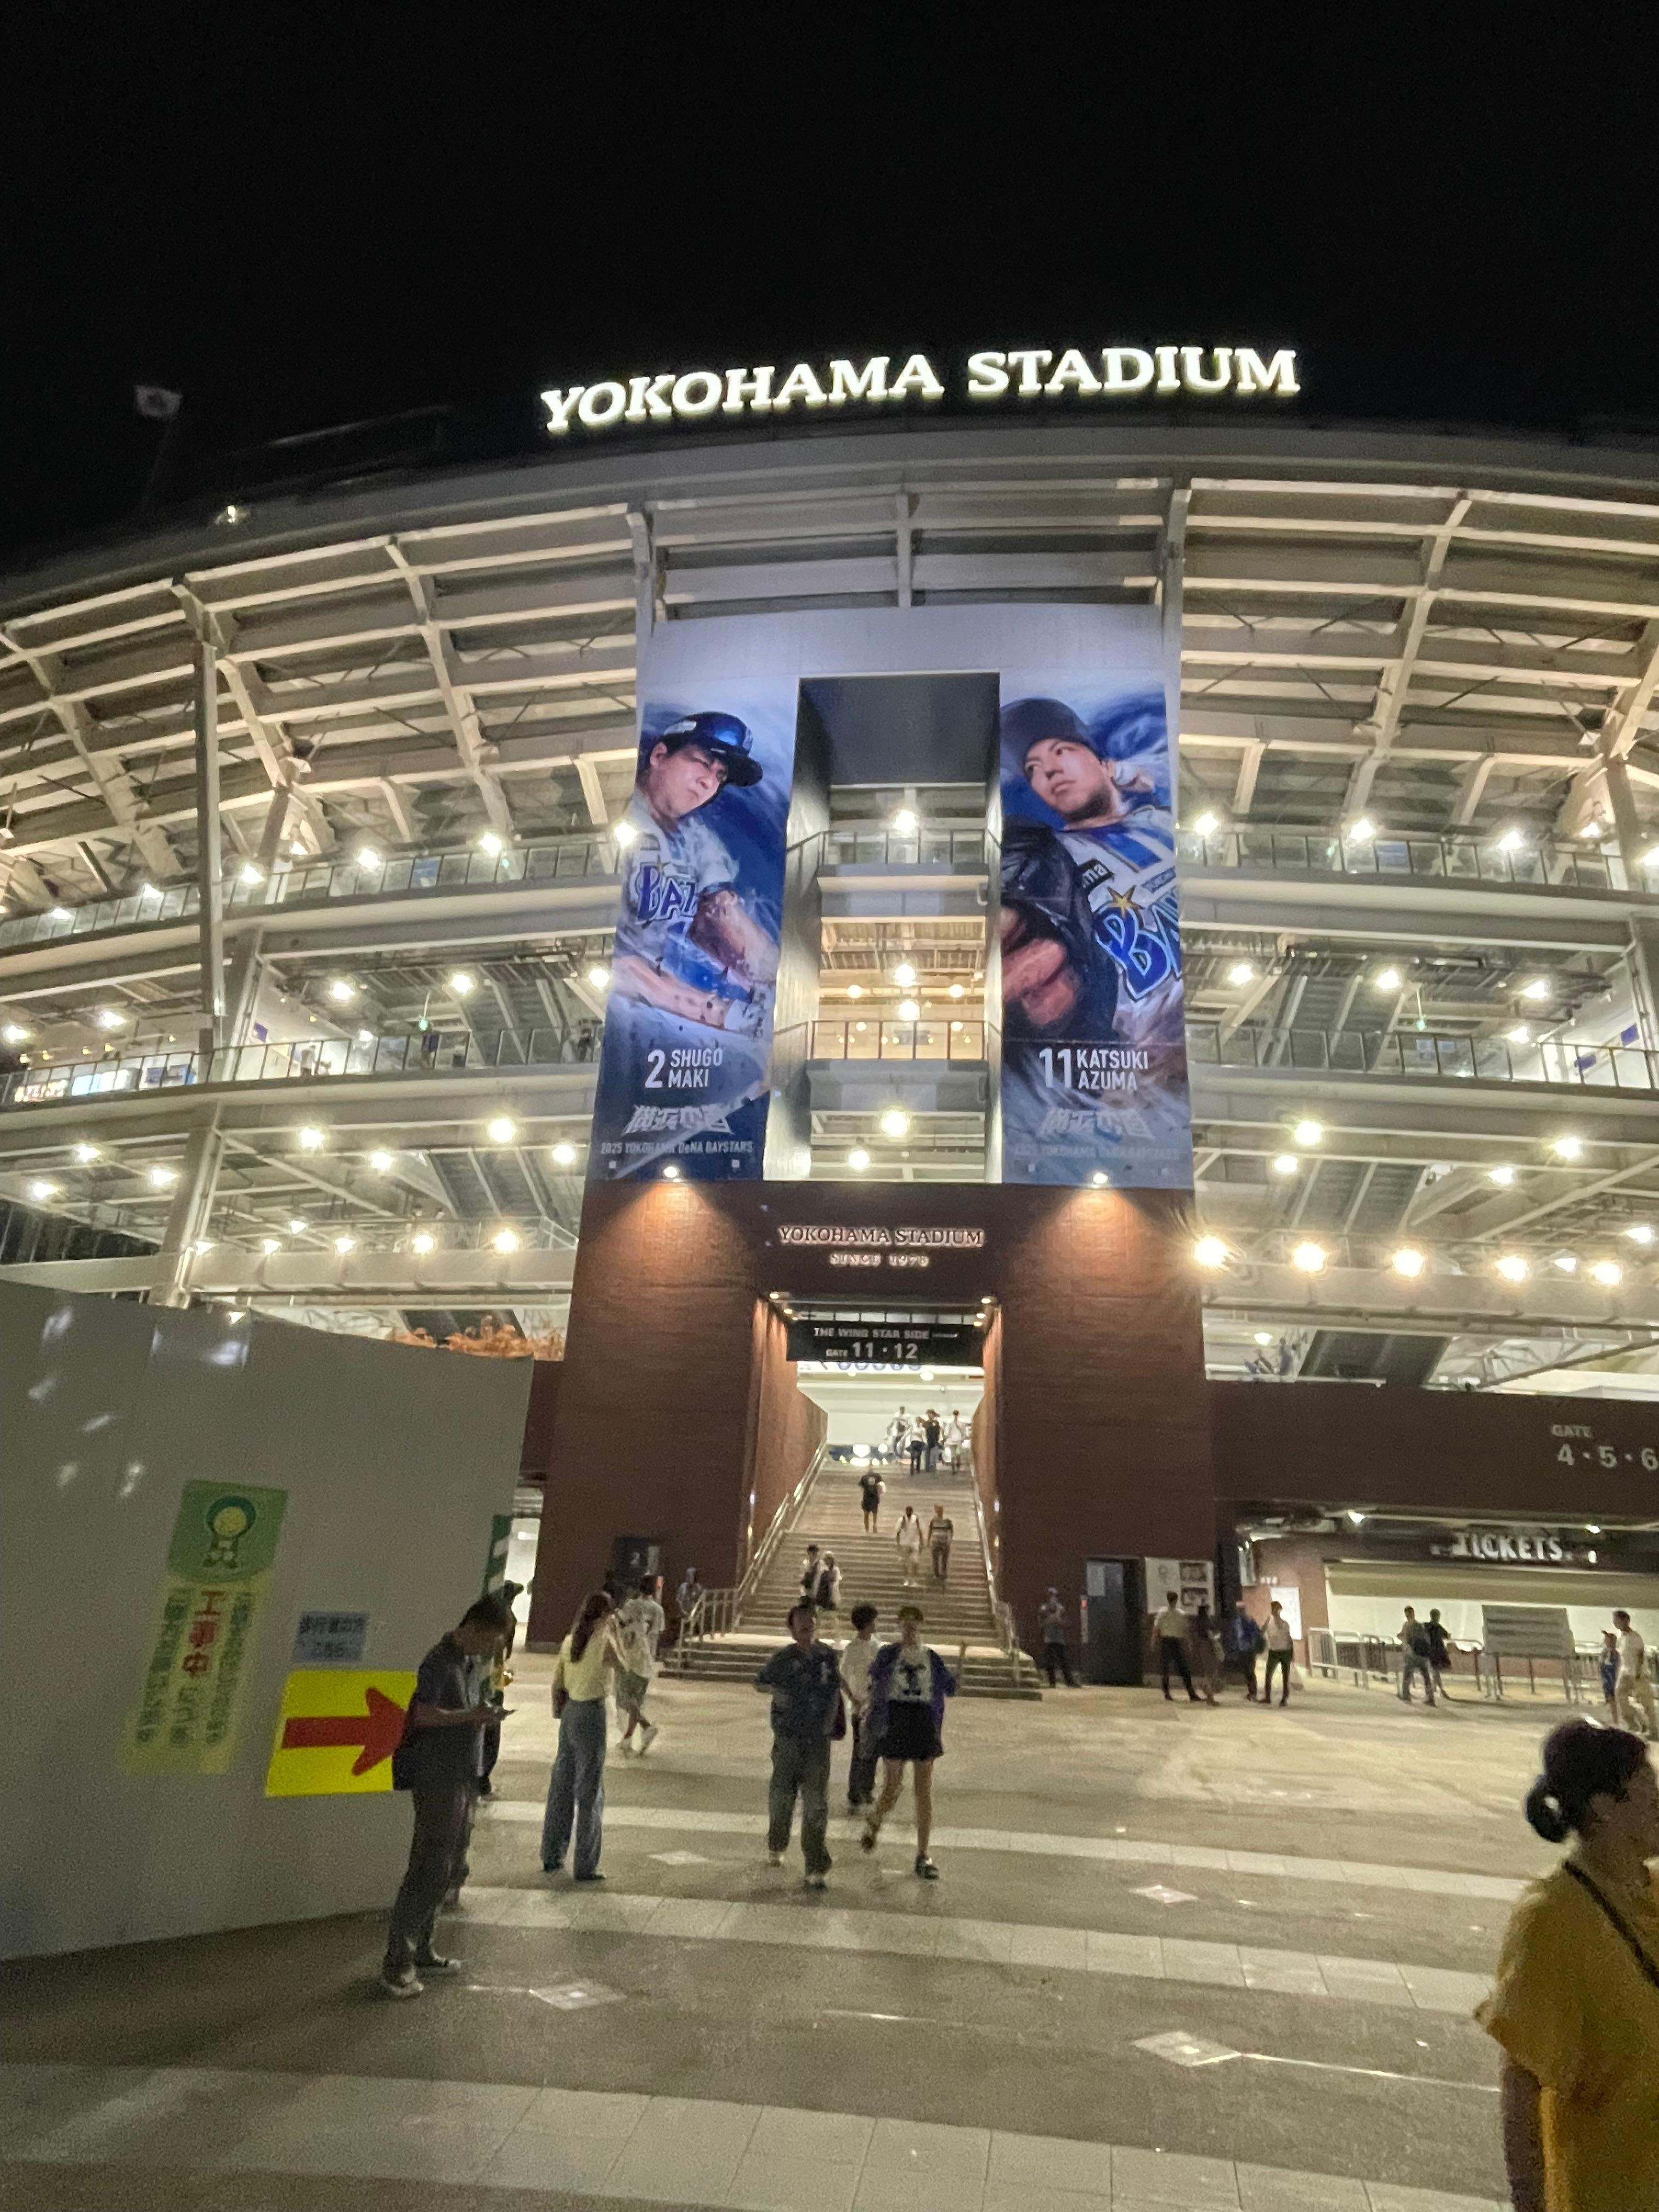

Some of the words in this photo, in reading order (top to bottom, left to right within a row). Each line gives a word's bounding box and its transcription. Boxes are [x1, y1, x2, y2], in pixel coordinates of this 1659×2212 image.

[540, 354, 944, 433] YOKOHAMA
[967, 346, 1301, 397] STADIUM
[670, 1048, 723, 1068] SHUGO
[1039, 1048, 1071, 1088] 11
[1076, 1049, 1149, 1070] KATSUKI
[644, 1049, 666, 1088] 2
[668, 1069, 709, 1088] MAKI
[1079, 1071, 1138, 1090] AZUMA
[706, 1140, 753, 1154] BAYSTARS
[777, 1226, 892, 1246] YOKOHAMA
[894, 1228, 986, 1248] STADIUM
[829, 1252, 882, 1267] SINCE
[814, 1328, 835, 1336] THE
[872, 1329, 901, 1339] STAR
[903, 1330, 930, 1340] SIDE
